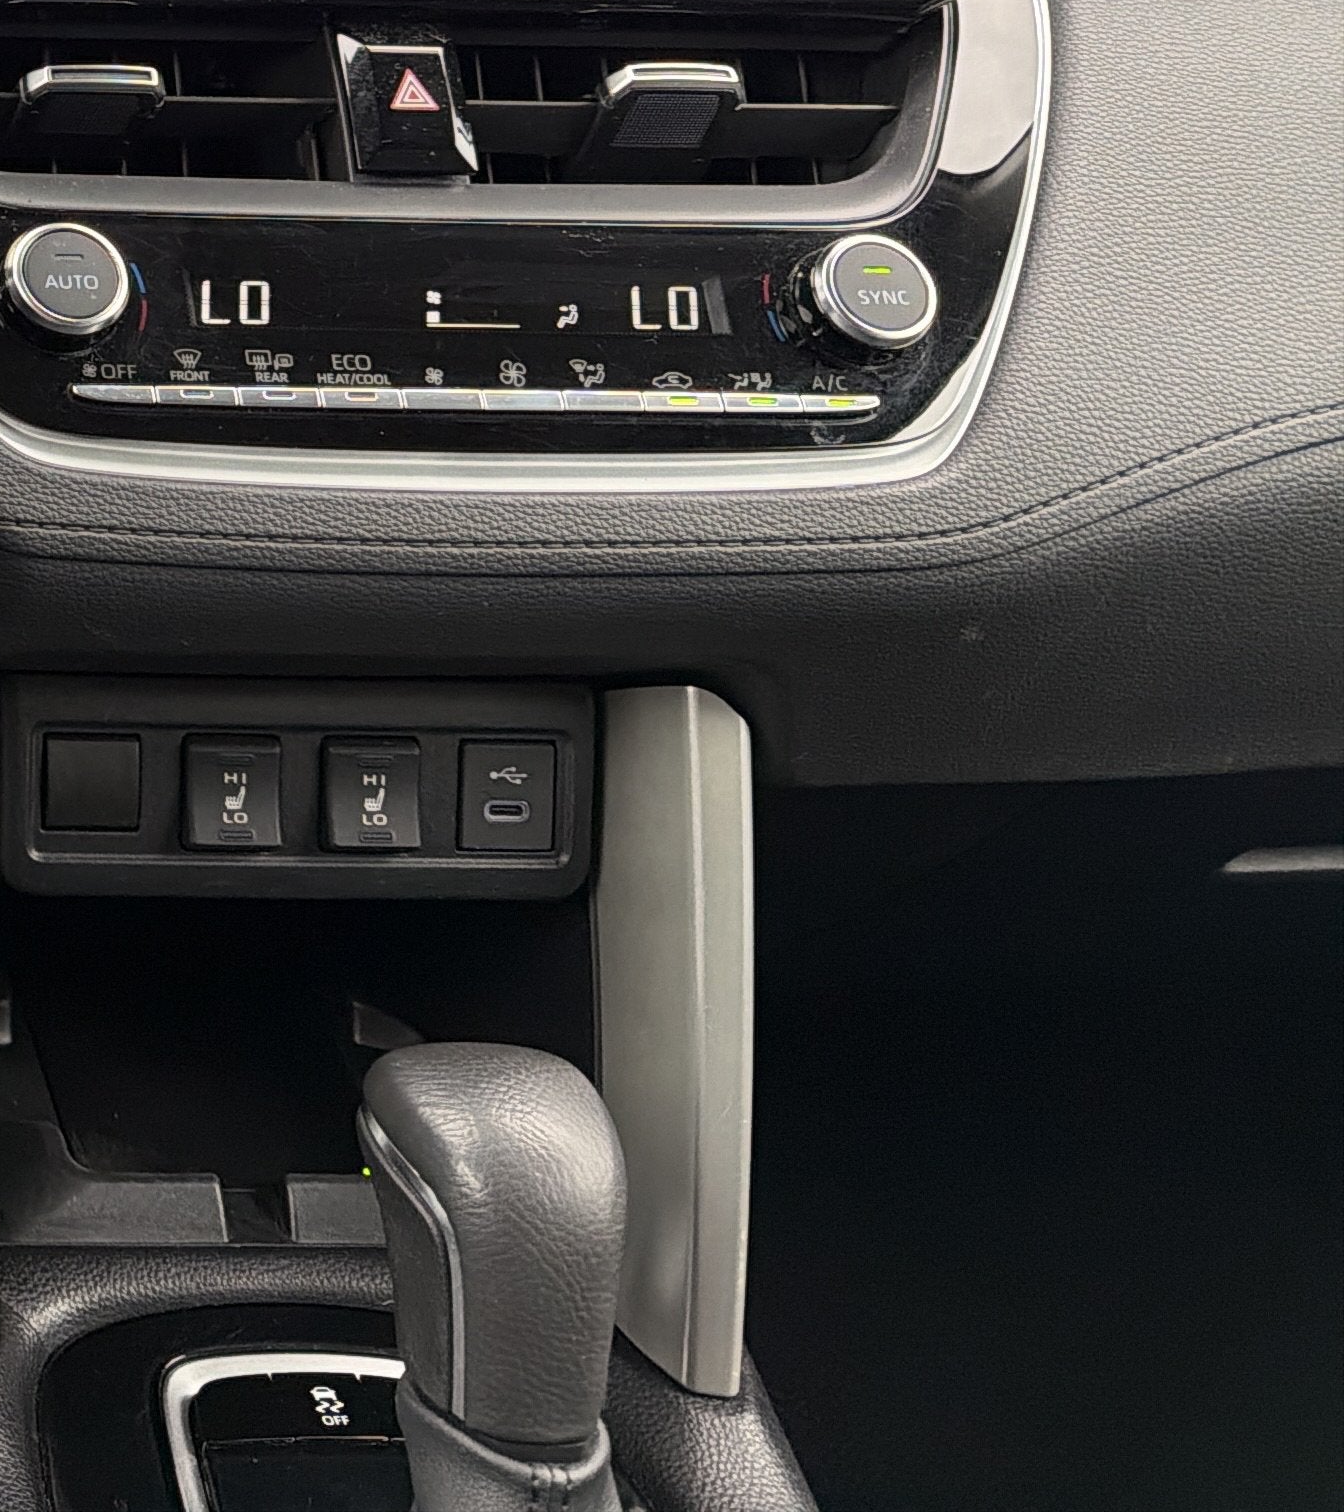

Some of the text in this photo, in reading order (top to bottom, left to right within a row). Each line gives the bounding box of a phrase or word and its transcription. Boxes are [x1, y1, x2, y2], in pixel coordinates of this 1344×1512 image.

[44, 274, 99, 291] AUTO
[200, 279, 271, 326] LO
[856, 289, 912, 306] SYNC
[629, 285, 700, 332] LO
[331, 354, 373, 372] ECO
[100, 364, 139, 380] OFF
[169, 370, 211, 382] FRONT
[255, 371, 290, 384] REAR
[317, 372, 392, 386] HEAT/COOL
[811, 375, 849, 391] A/C
[224, 772, 247, 784] HI
[363, 774, 386, 786] HI
[222, 811, 249, 825] LO
[361, 813, 388, 827] LO
[322, 1414, 350, 1426] OFF
